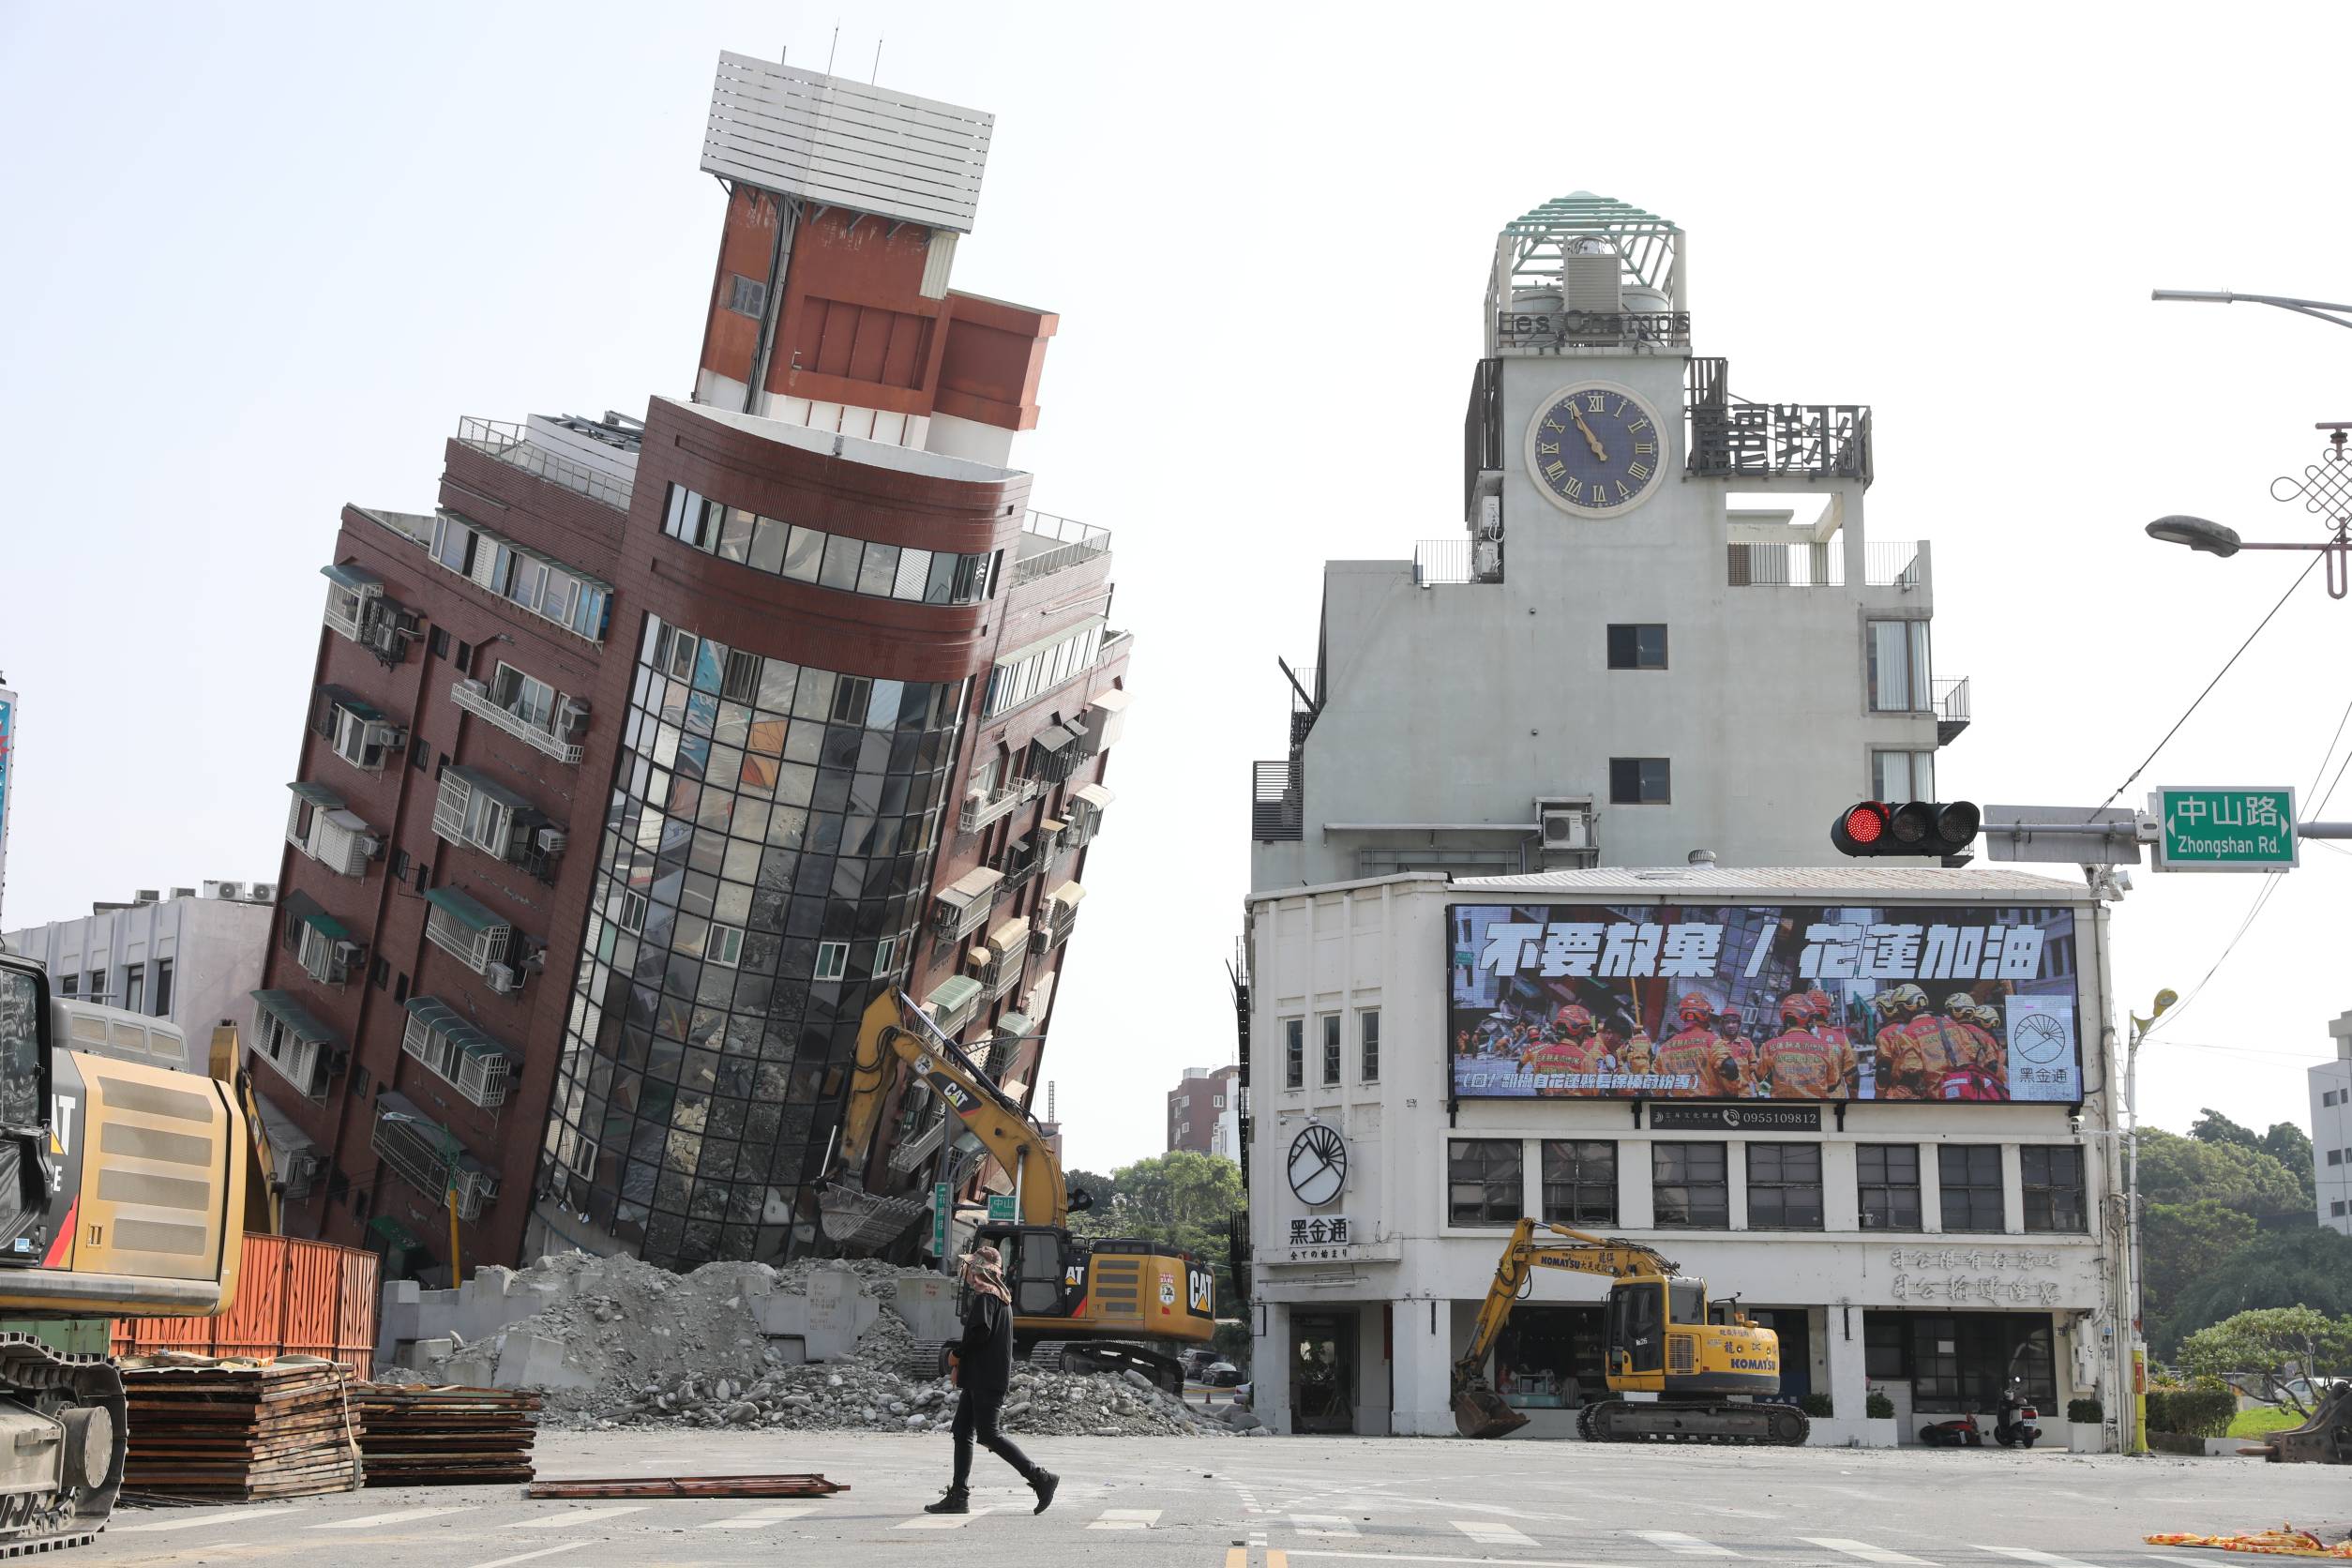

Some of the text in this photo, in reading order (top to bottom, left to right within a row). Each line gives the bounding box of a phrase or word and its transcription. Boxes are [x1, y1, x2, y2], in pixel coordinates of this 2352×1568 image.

[1499, 310, 1549, 335] Les
[1588, 396, 1605, 413] XII
[1636, 442, 1653, 454] III
[2178, 796, 2278, 826] 中山路
[2178, 836, 2281, 858] Zhongshan Rd.
[1479, 922, 1724, 977] 不要放棄
[1799, 923, 2045, 980] 花蓮加油
[2019, 1067, 2069, 1083] 黑金通
[943, 1082, 969, 1108] CAT
[1743, 1112, 1817, 1124] 0955109812
[993, 1199, 1014, 1209] 中山
[1289, 1218, 1347, 1244] 黑金通
[1290, 1249, 1347, 1260] 全ての始まり
[1541, 1255, 1581, 1270] KOMATSU
[1065, 1266, 1085, 1286] AT
[1189, 1270, 1213, 1313] CAT
[1730, 1358, 1776, 1371] KOMATSU
